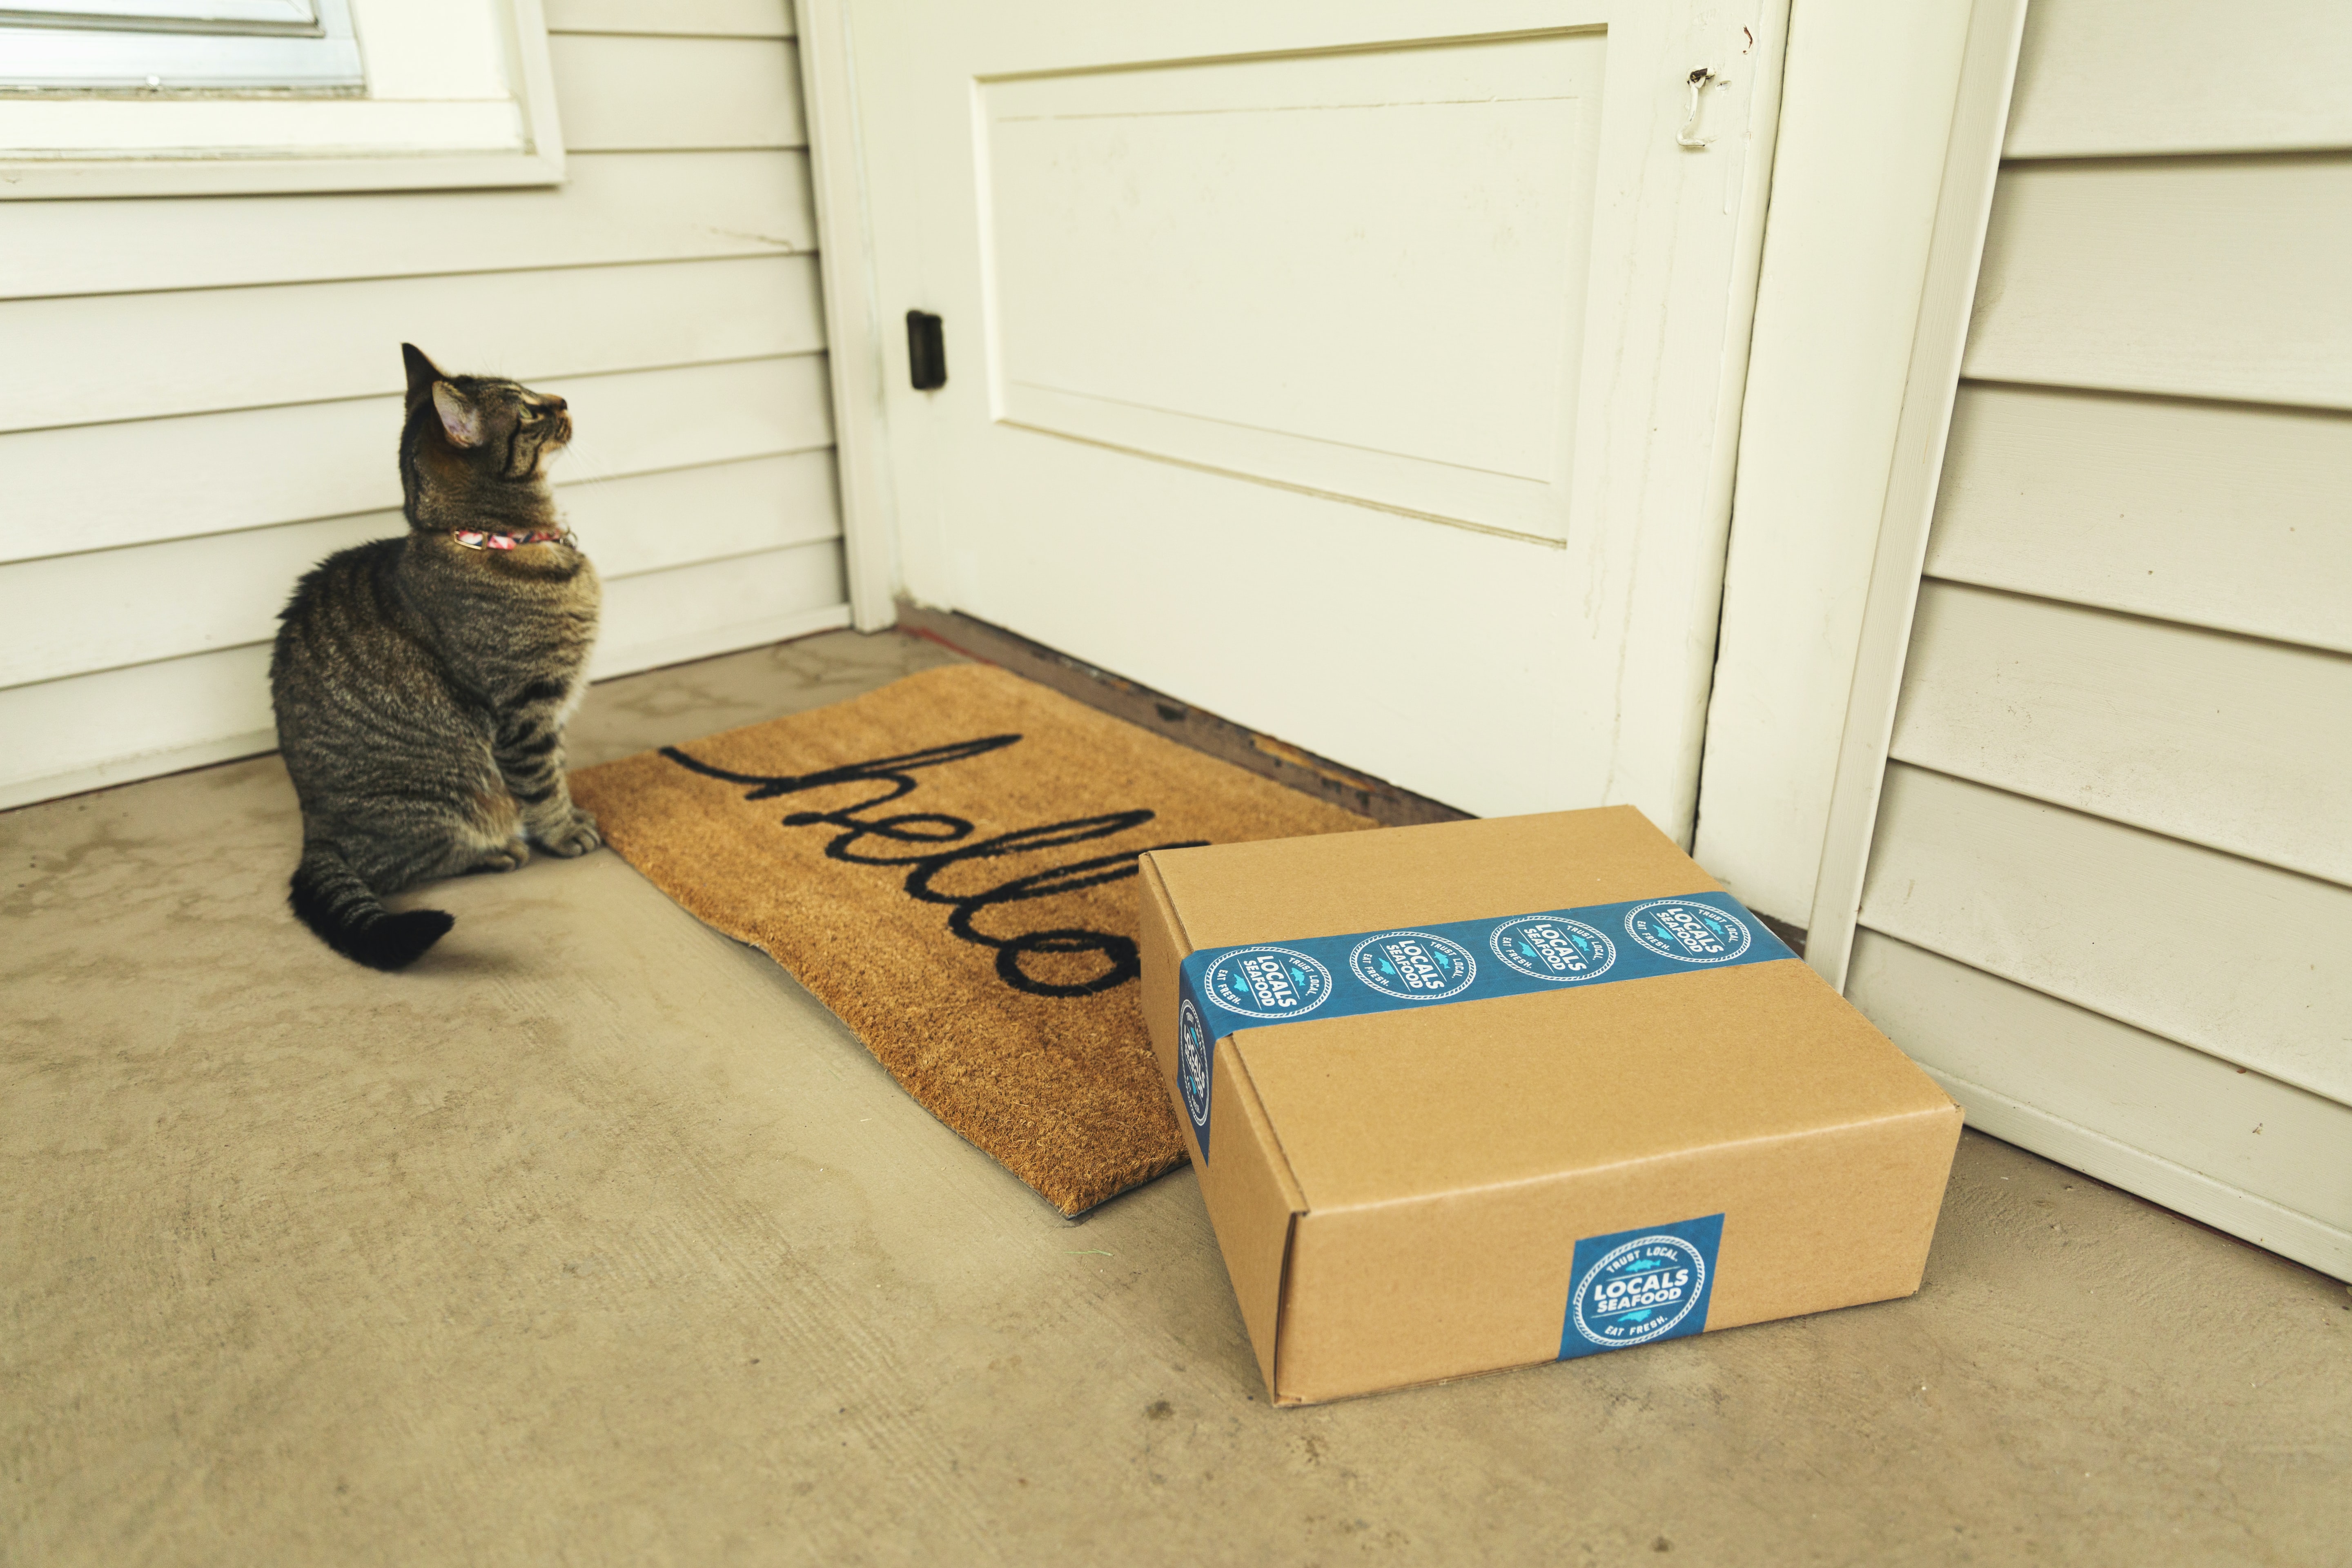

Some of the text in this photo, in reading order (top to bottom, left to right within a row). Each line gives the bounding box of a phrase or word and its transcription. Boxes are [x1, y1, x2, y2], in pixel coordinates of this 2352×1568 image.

[658, 734, 1211, 997] hello
[1567, 925, 1594, 939] TRUST
[1637, 920, 1647, 930] EAT
[1656, 912, 1703, 952] SEAFOOD
[1667, 908, 1724, 953] LOCALS
[1698, 909, 1727, 923] TRUST
[1430, 942, 1457, 956] TRUST
[1502, 937, 1512, 947] EAT
[1523, 929, 1566, 970] SEAFOOD
[1535, 924, 1587, 971] LOCALS
[1216, 969, 1228, 980] EAT
[1289, 957, 1314, 973] TRUST
[1362, 953, 1372, 964] EAT
[1386, 944, 1423, 988] SEAFOOD
[1398, 940, 1445, 989] LOCALS
[1243, 960, 1275, 1006] SEAFOOD
[1257, 956, 1297, 1007] LOCALS
[1184, 1024, 1205, 1089] LOCALS
[1185, 1043, 1203, 1098] SEAFOOD
[1606, 1250, 1640, 1273] TRUST
[1594, 1269, 1688, 1301] LOCALS
[1597, 1288, 1682, 1313] SEAFOOD
[1604, 1325, 1624, 1336] EAT
